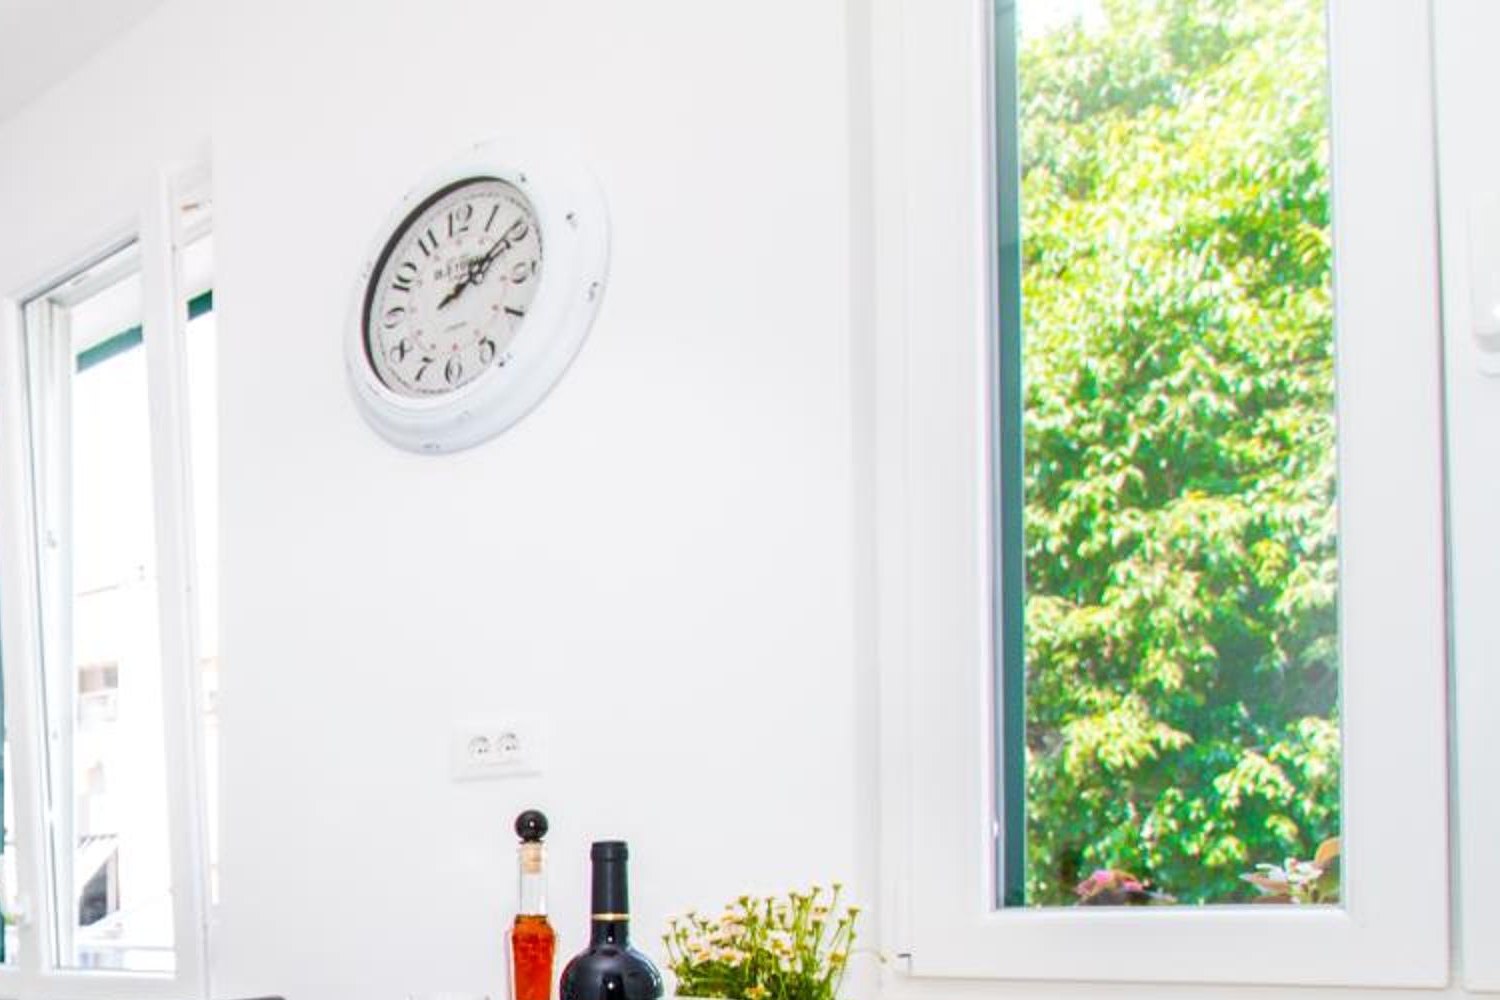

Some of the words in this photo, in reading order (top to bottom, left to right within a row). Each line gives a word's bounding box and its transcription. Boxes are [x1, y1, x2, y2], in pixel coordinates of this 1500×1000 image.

[446, 203, 473, 237] 12
[416, 228, 439, 257] 11
[392, 261, 417, 292] 10
[415, 355, 434, 382] 7
[444, 353, 463, 384] 6
